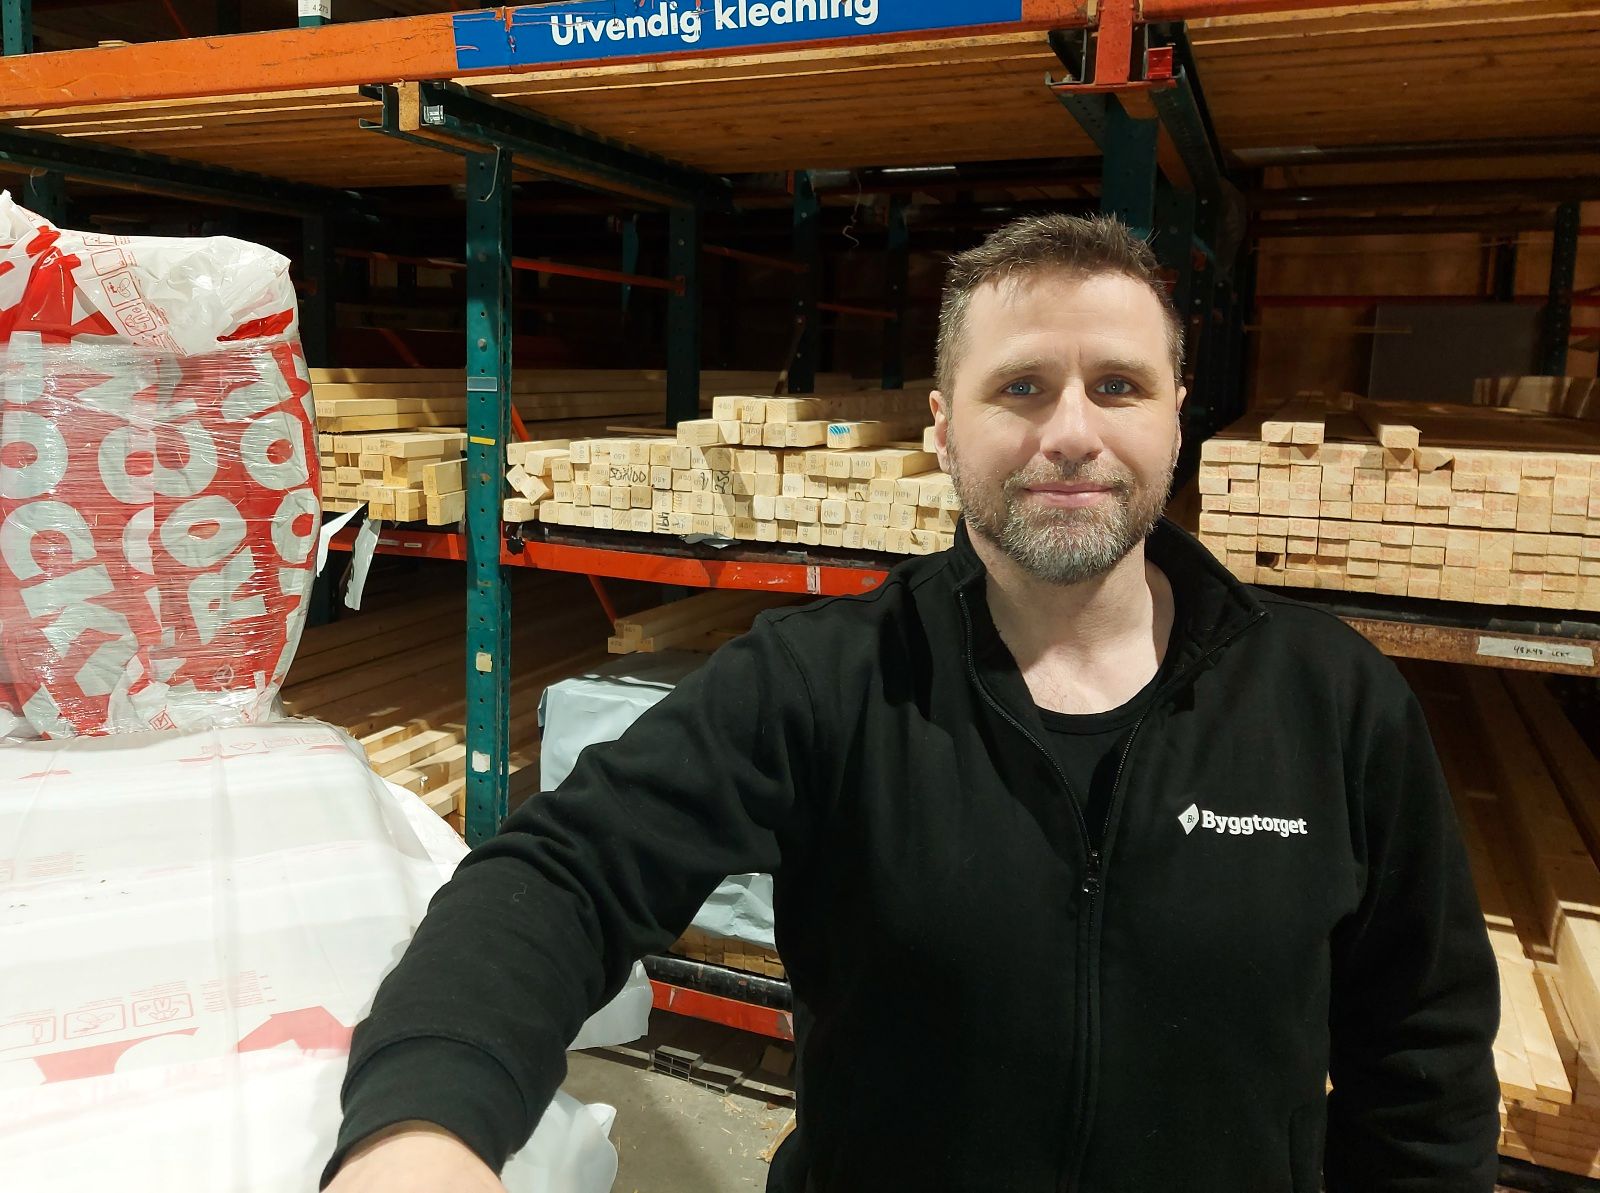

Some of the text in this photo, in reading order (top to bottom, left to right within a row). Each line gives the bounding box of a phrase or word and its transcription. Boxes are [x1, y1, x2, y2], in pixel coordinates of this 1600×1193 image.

[550, 0, 880, 47] Utvendig kledning
[855, 460, 871, 468] 480
[1201, 809, 1308, 838] Byggtorget
